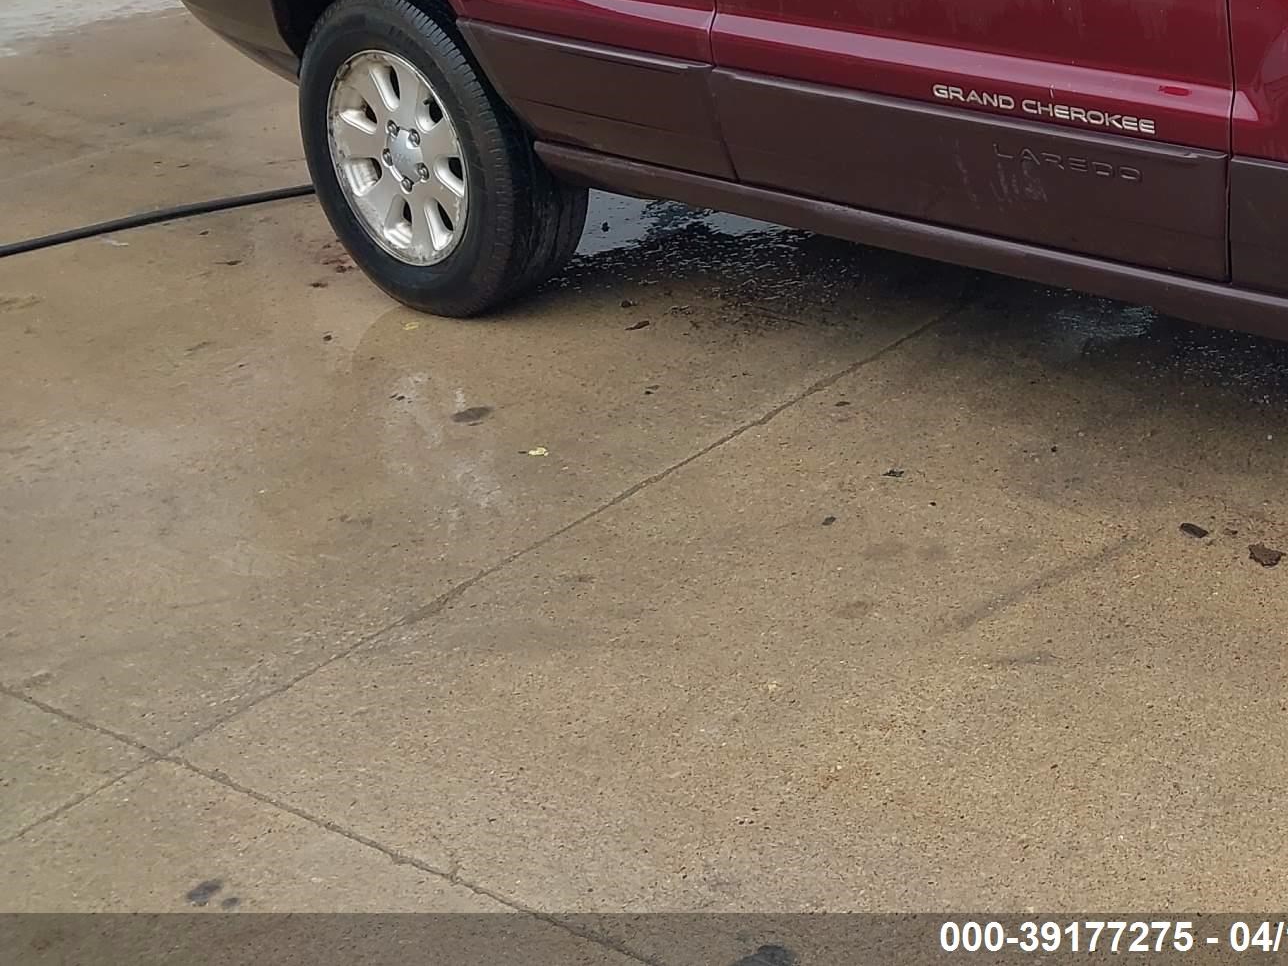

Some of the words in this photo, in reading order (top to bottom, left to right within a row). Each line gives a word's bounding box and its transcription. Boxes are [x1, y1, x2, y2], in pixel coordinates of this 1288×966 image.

[933, 84, 1015, 110] GRAND
[1021, 100, 1156, 135] CHEROKEE
[994, 143, 1142, 182] LAREDO
